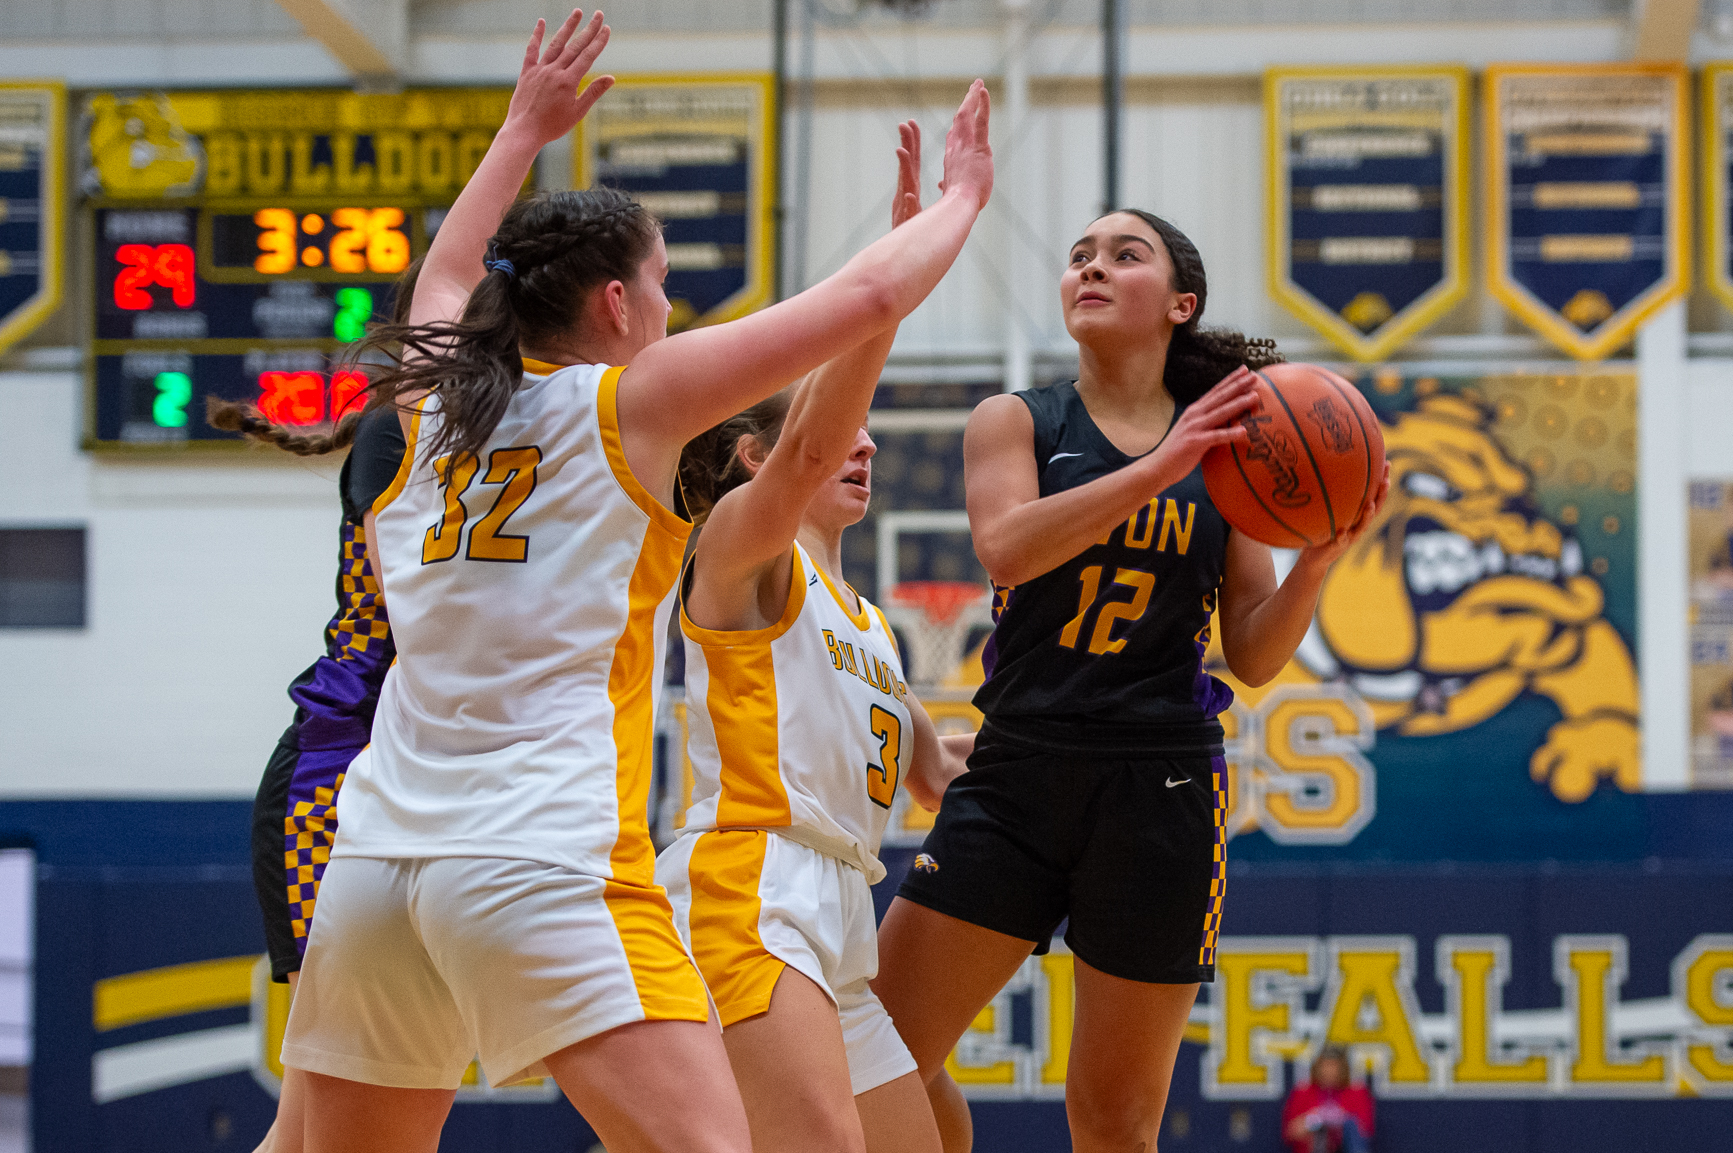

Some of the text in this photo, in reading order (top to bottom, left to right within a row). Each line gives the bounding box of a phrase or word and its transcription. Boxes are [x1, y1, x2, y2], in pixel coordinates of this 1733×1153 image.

[114, 243, 195, 310] 29
[254, 207, 410, 274] 3:26
[153, 371, 192, 427] 2
[420, 445, 543, 566] 32
[1058, 565, 1156, 655] 12
[866, 703, 902, 810] 3
